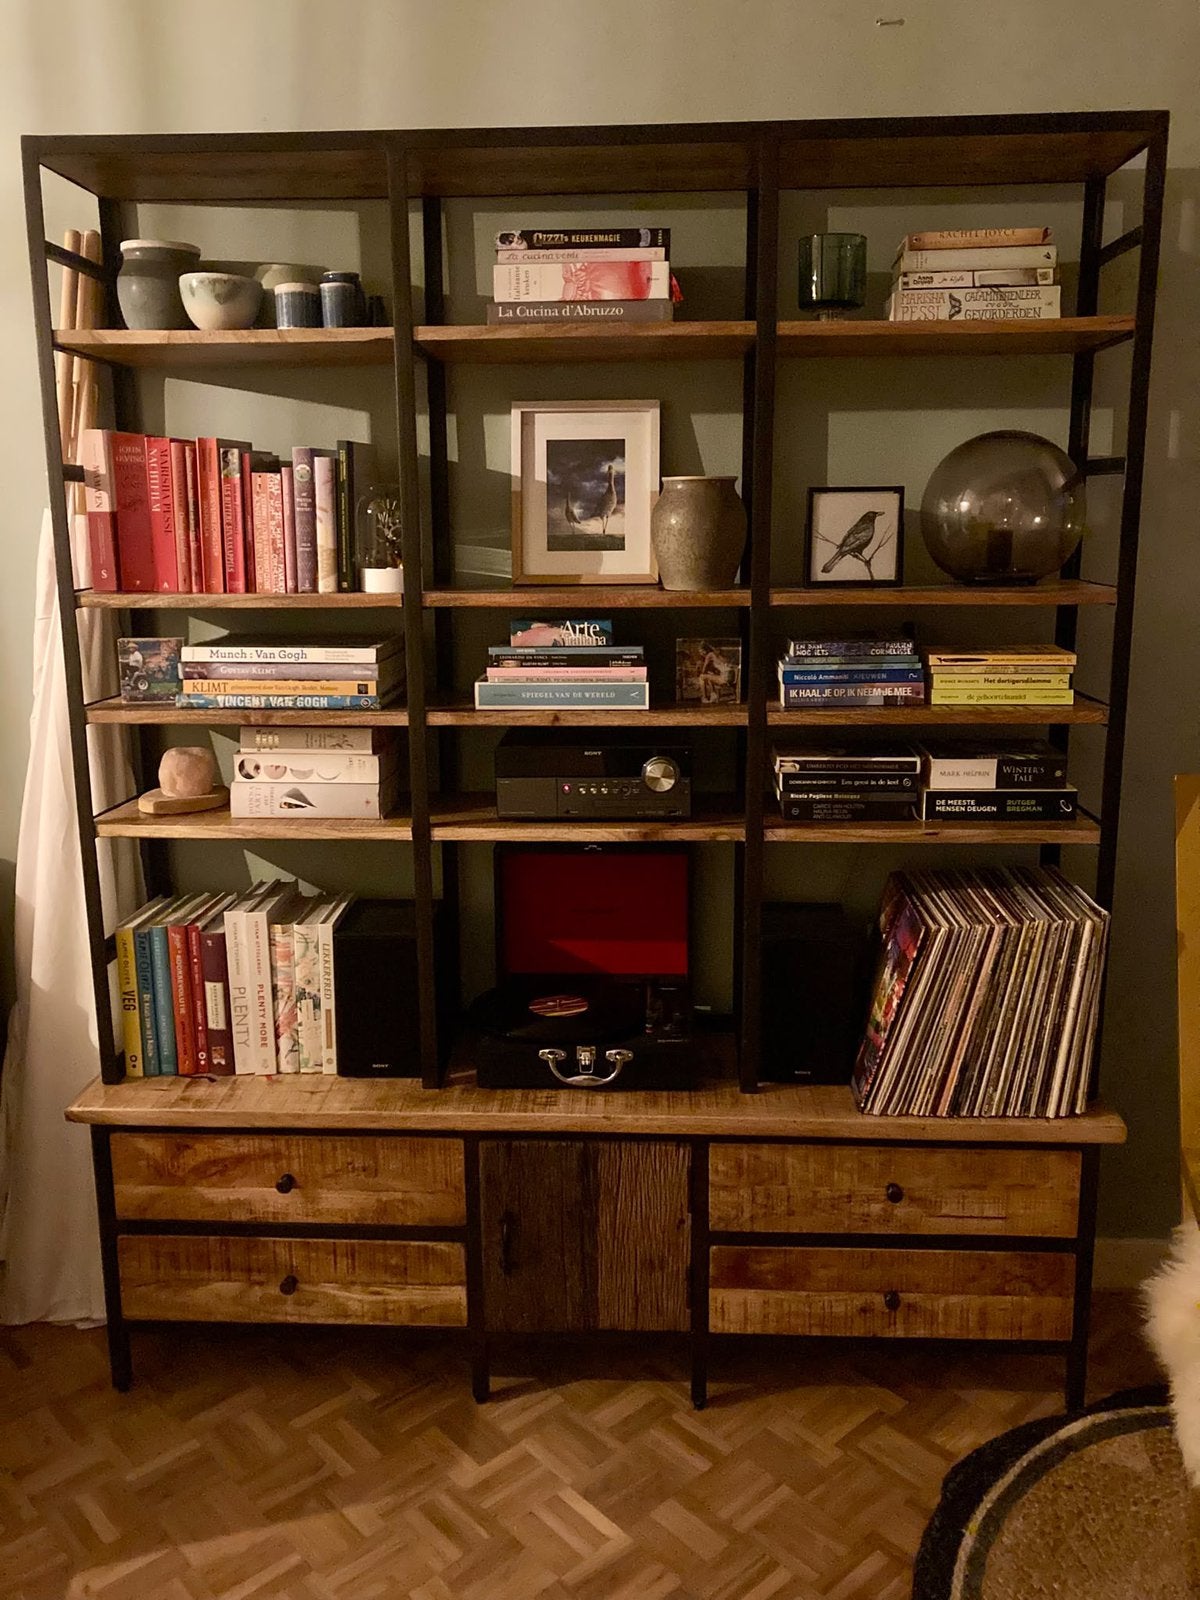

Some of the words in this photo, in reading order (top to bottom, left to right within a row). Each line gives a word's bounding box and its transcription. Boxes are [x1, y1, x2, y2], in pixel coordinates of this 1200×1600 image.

[571, 234, 621, 243] KEUKENMAGIE
[900, 292, 946, 305] MARISHA
[498, 306, 513, 317] La
[516, 305, 559, 317] Cucina
[562, 304, 624, 316] d'Abruzzo
[160, 448, 171, 500] MARISHA
[209, 649, 247, 659] Munch
[255, 650, 276, 659] Van
[278, 650, 308, 661] Gogh
[252, 667, 276, 675] KLIMT
[192, 682, 229, 693] KLIMT
[789, 689, 798, 698] IK
[799, 689, 820, 698] HAAL
[823, 688, 833, 698] JE
[847, 688, 855, 697] IK
[857, 688, 881, 696] NEEM
[882, 687, 893, 696] JE
[893, 687, 912, 696] MEE
[216, 696, 267, 707] VINCENT
[269, 696, 295, 707] VAN
[296, 696, 328, 707] GOGH
[1013, 774, 1033, 782] TALE
[122, 990, 137, 1011] VEG
[257, 984, 265, 1019] PLENTY
[233, 986, 250, 1048] PLENTY
[260, 1022, 268, 1048] MORE
